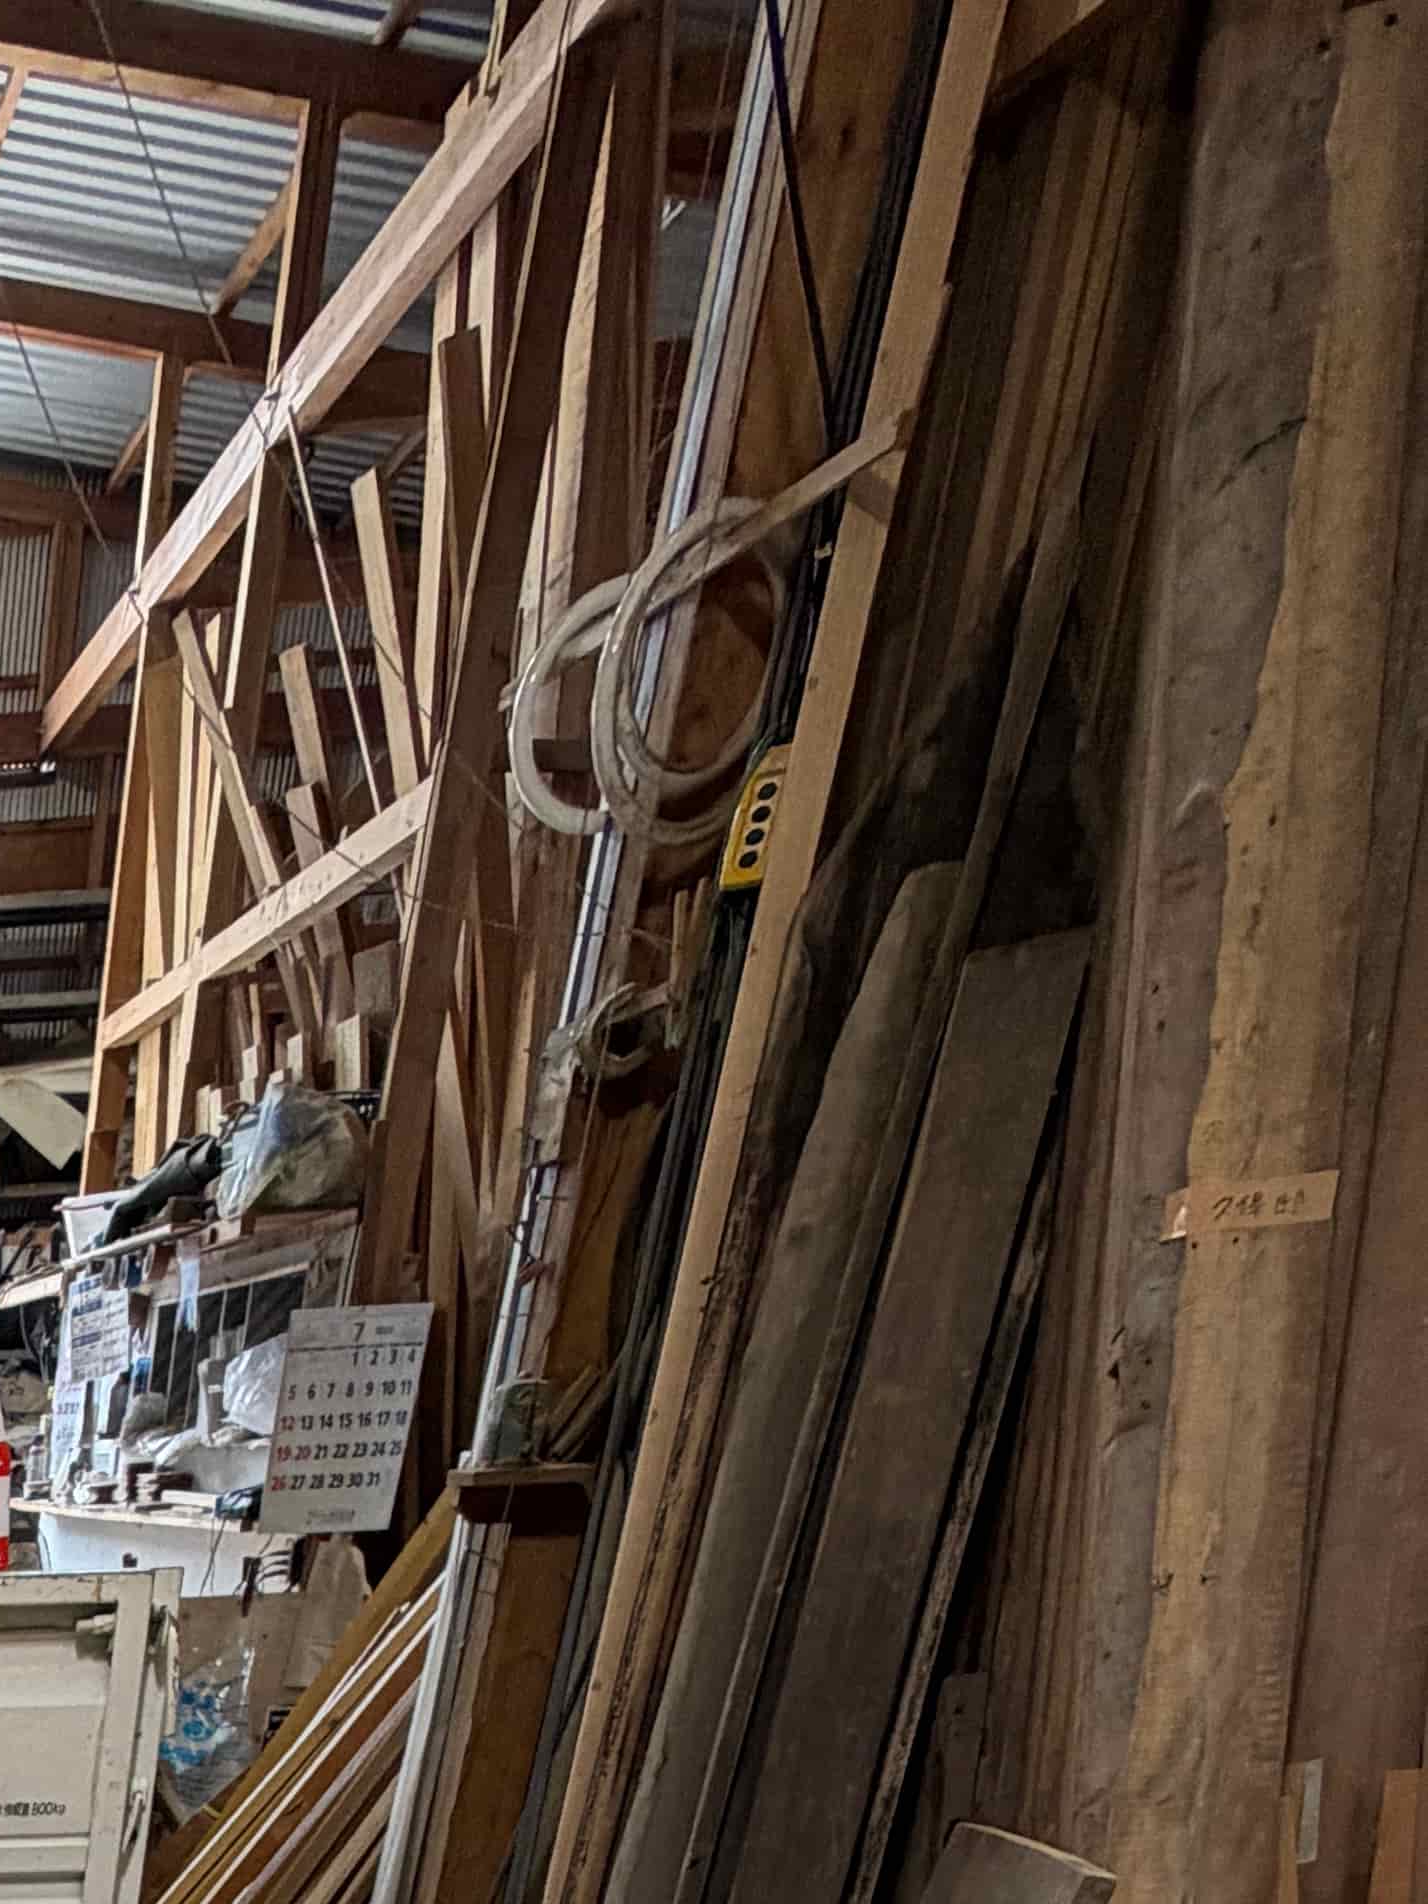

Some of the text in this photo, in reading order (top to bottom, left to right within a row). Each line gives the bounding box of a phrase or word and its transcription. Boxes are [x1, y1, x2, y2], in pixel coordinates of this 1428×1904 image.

[353, 1322, 366, 1342] 7
[352, 1349, 416, 1366] 1 2 3 4
[307, 1384, 316, 1399] 6
[326, 1383, 335, 1398] 7
[346, 1382, 354, 1398] 8
[364, 1381, 374, 1397] 9
[382, 1380, 396, 1395] 10
[400, 1380, 413, 1395] 11
[301, 1415, 314, 1430] 13
[320, 1414, 333, 1429] 14
[339, 1414, 352, 1428] 15
[358, 1412, 372, 1427] 16
[377, 1411, 390, 1426] 17
[276, 1446, 291, 1461] 19
[295, 1445, 312, 1460] 20
[314, 1444, 329, 1460] 21
[332, 1444, 348, 1458] 22
[352, 1443, 368, 1457] 23
[371, 1441, 386, 1456] 24
[290, 1475, 305, 1490] 27
[309, 1474, 324, 1489] 28
[328, 1473, 344, 1488] 29
[347, 1472, 363, 1487] 30
[365, 1472, 380, 1486] 31
